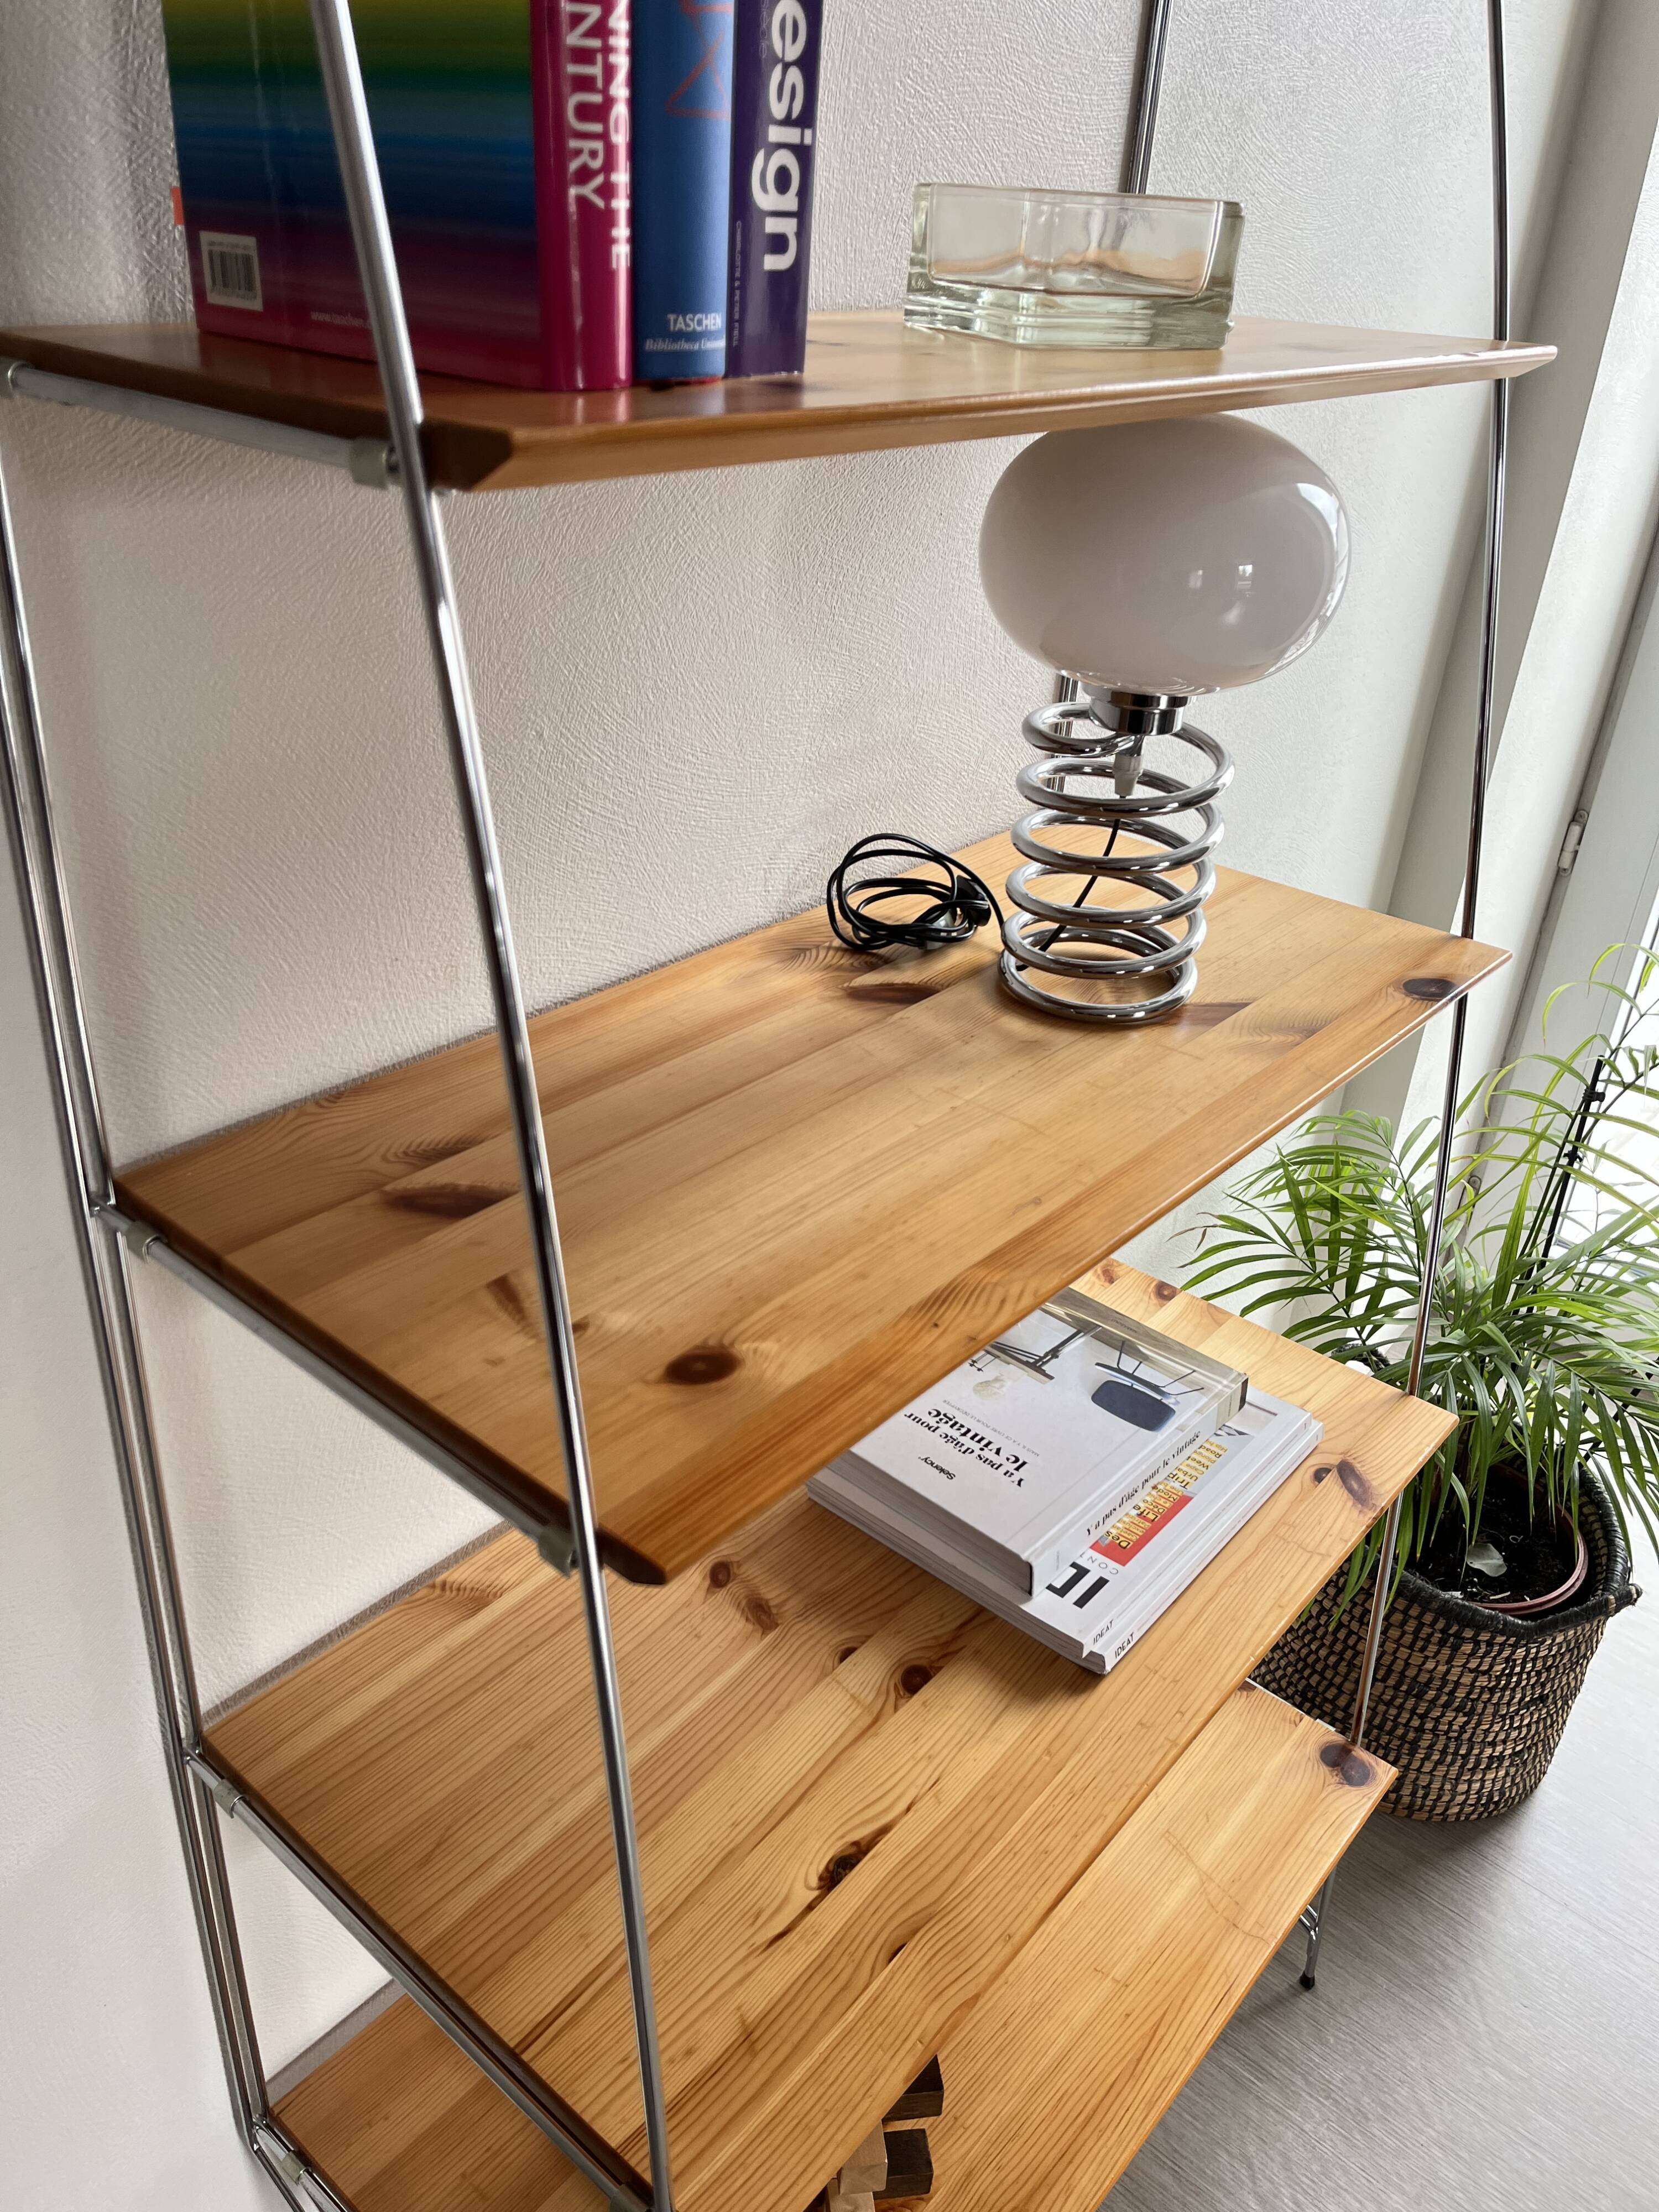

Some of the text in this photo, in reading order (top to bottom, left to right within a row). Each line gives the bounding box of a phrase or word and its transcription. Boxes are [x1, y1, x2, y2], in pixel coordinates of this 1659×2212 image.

[565, 3, 605, 210] NTURY
[751, 0, 812, 272] esign
[611, 160, 631, 269] THE
[667, 312, 721, 332] TASCHEN
[904, 1413, 941, 1433] pour
[928, 1408, 1030, 1472] le vintage
[1198, 1444, 1222, 1458] Road
[975, 1454, 1004, 1471] pas
[1102, 1507, 1117, 1525] pas
[1141, 1466, 1161, 1489] pour
[1163, 1458, 1170, 1468] le
[1172, 1431, 1201, 1459] vintage
[1133, 1504, 1159, 1522] Life
[1104, 1531, 1131, 1550] Des
[1093, 1619, 1114, 1646] IDEAT
[1114, 1632, 1134, 1660] IDEAT
